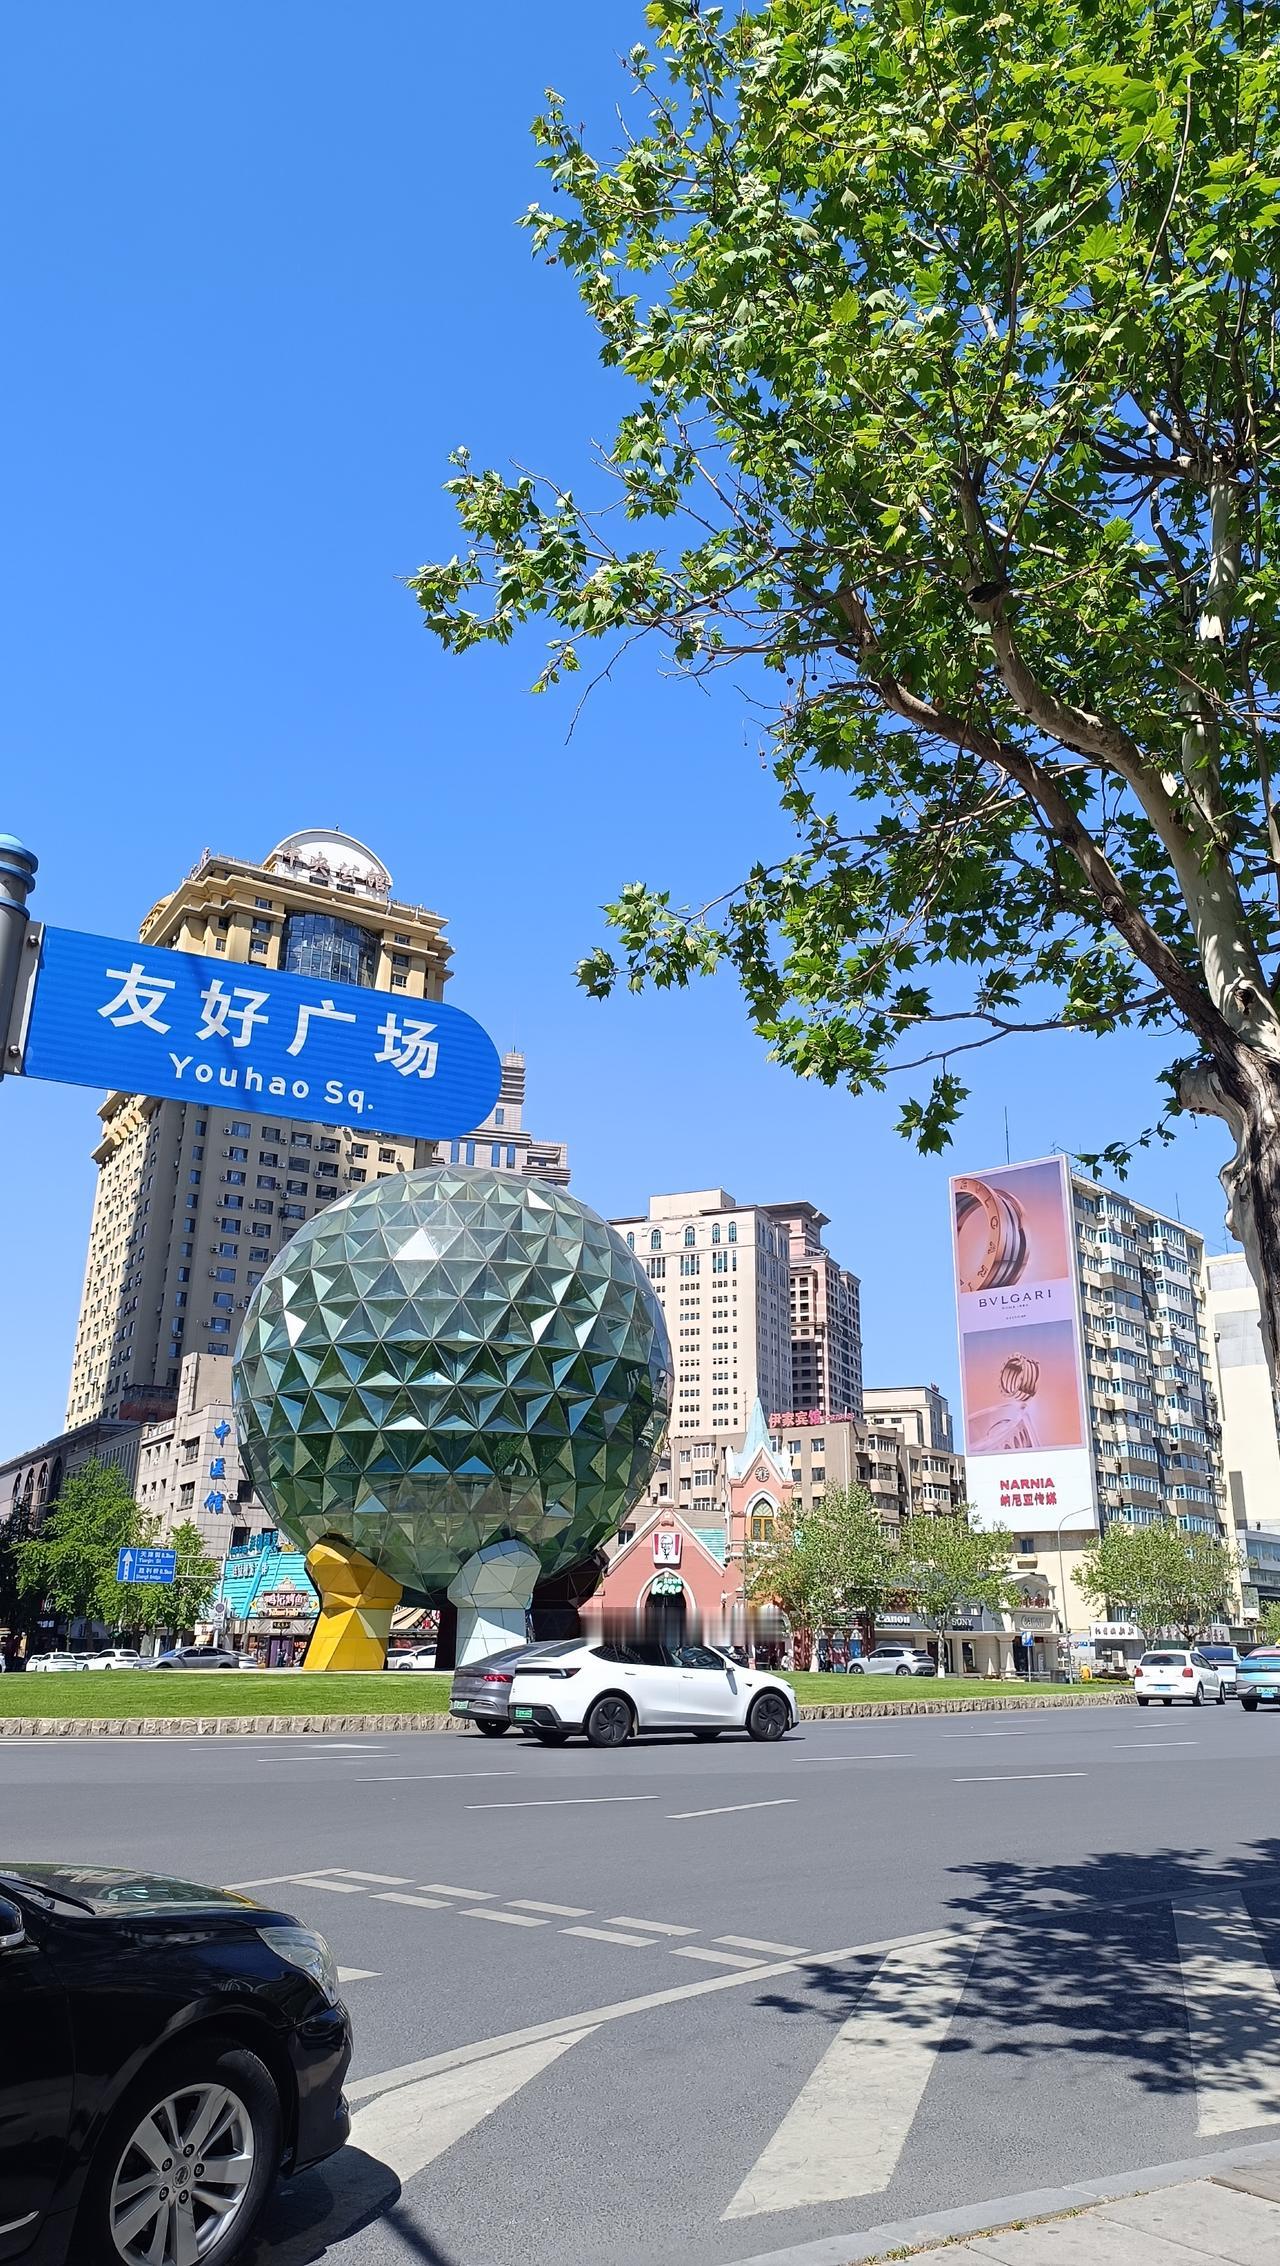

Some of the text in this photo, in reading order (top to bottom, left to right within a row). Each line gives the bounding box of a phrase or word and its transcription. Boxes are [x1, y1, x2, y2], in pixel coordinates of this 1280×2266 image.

[97, 962, 439, 1079] 友好广场
[169, 1052, 375, 1114] Youhao Sq.
[978, 1289, 1052, 1308] BVLGARI
[1000, 1477, 1056, 1491] NARNIA
[1000, 1491, 1057, 1507] 纳尼亚传媒
[875, 1614, 911, 1624] Canon
[951, 1617, 973, 1627] SONY
